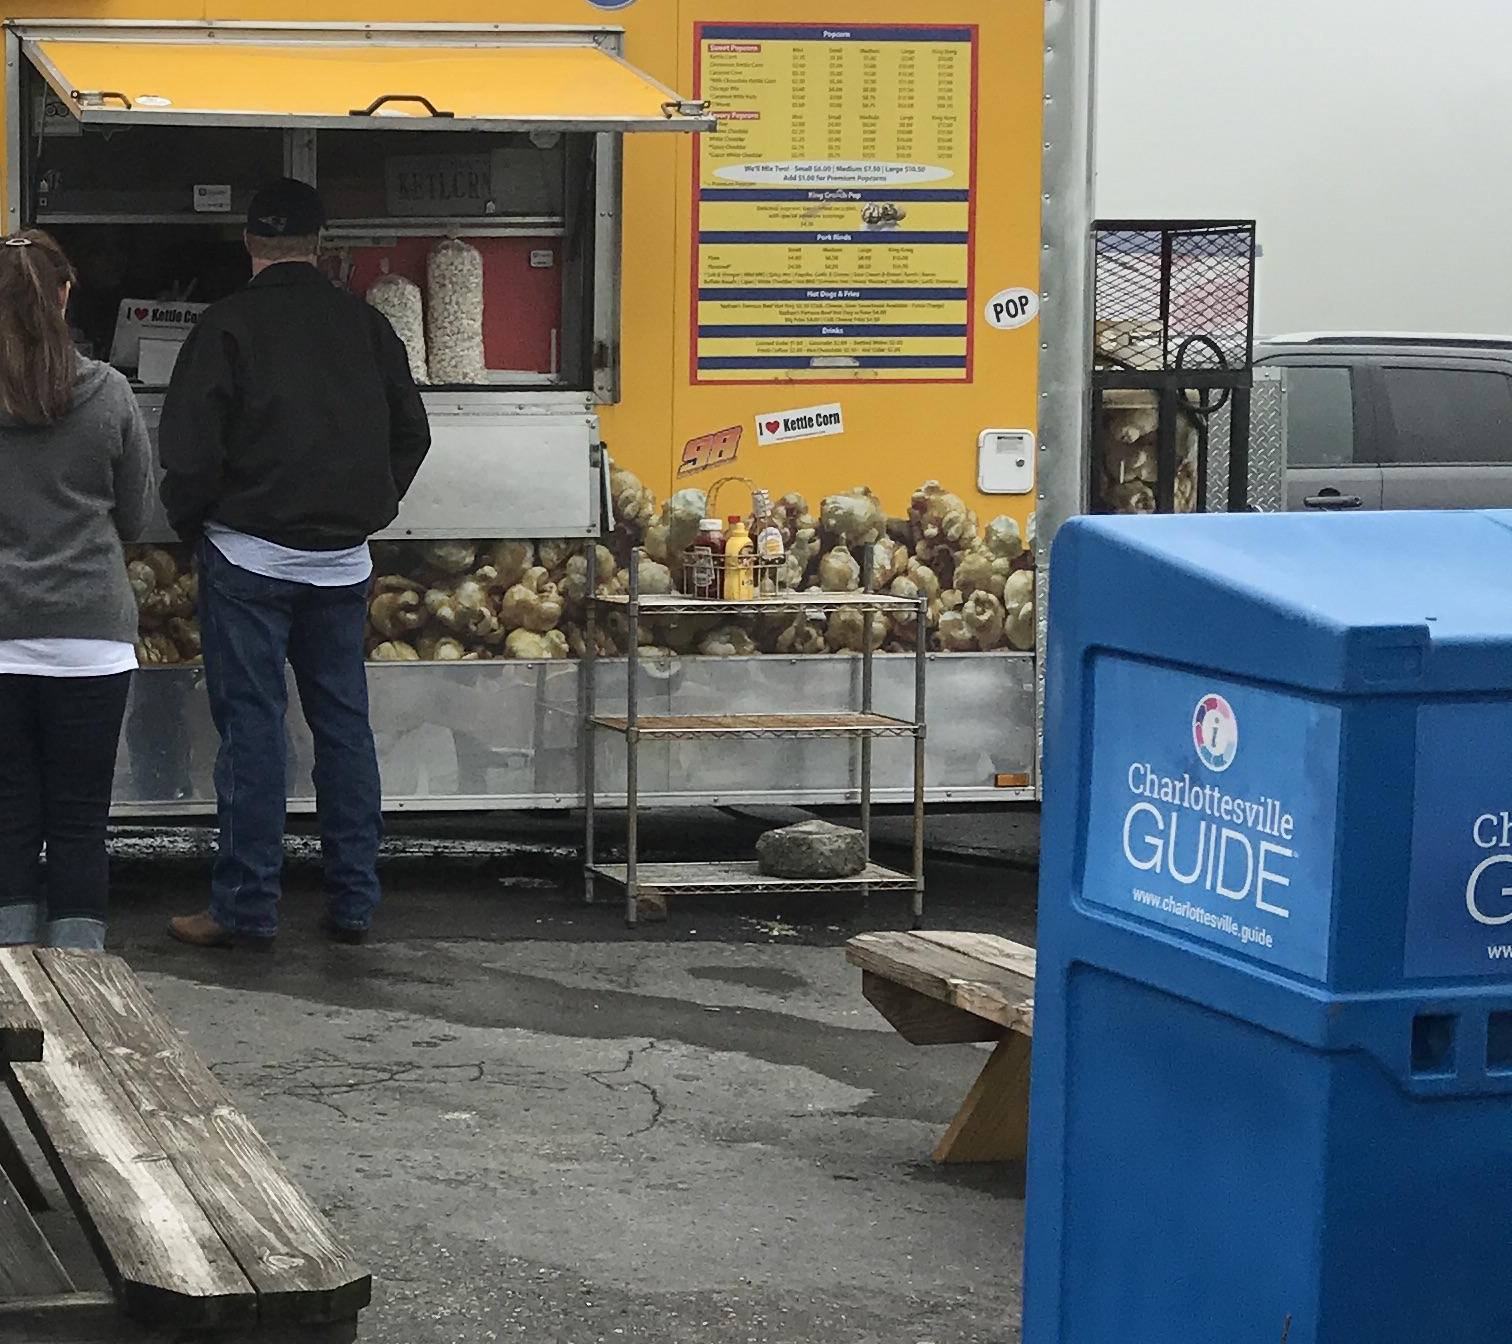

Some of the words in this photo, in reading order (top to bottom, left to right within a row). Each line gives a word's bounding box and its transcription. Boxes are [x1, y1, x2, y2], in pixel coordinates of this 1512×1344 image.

[152, 308, 183, 323] Kettle
[993, 295, 1029, 323] POP
[783, 414, 814, 433] Kettle
[815, 412, 841, 427] Corn
[1128, 762, 1294, 840] Charlottesville
[1123, 801, 1294, 918] GUIDE
[1132, 887, 1274, 949] www.charlottesville.guide
